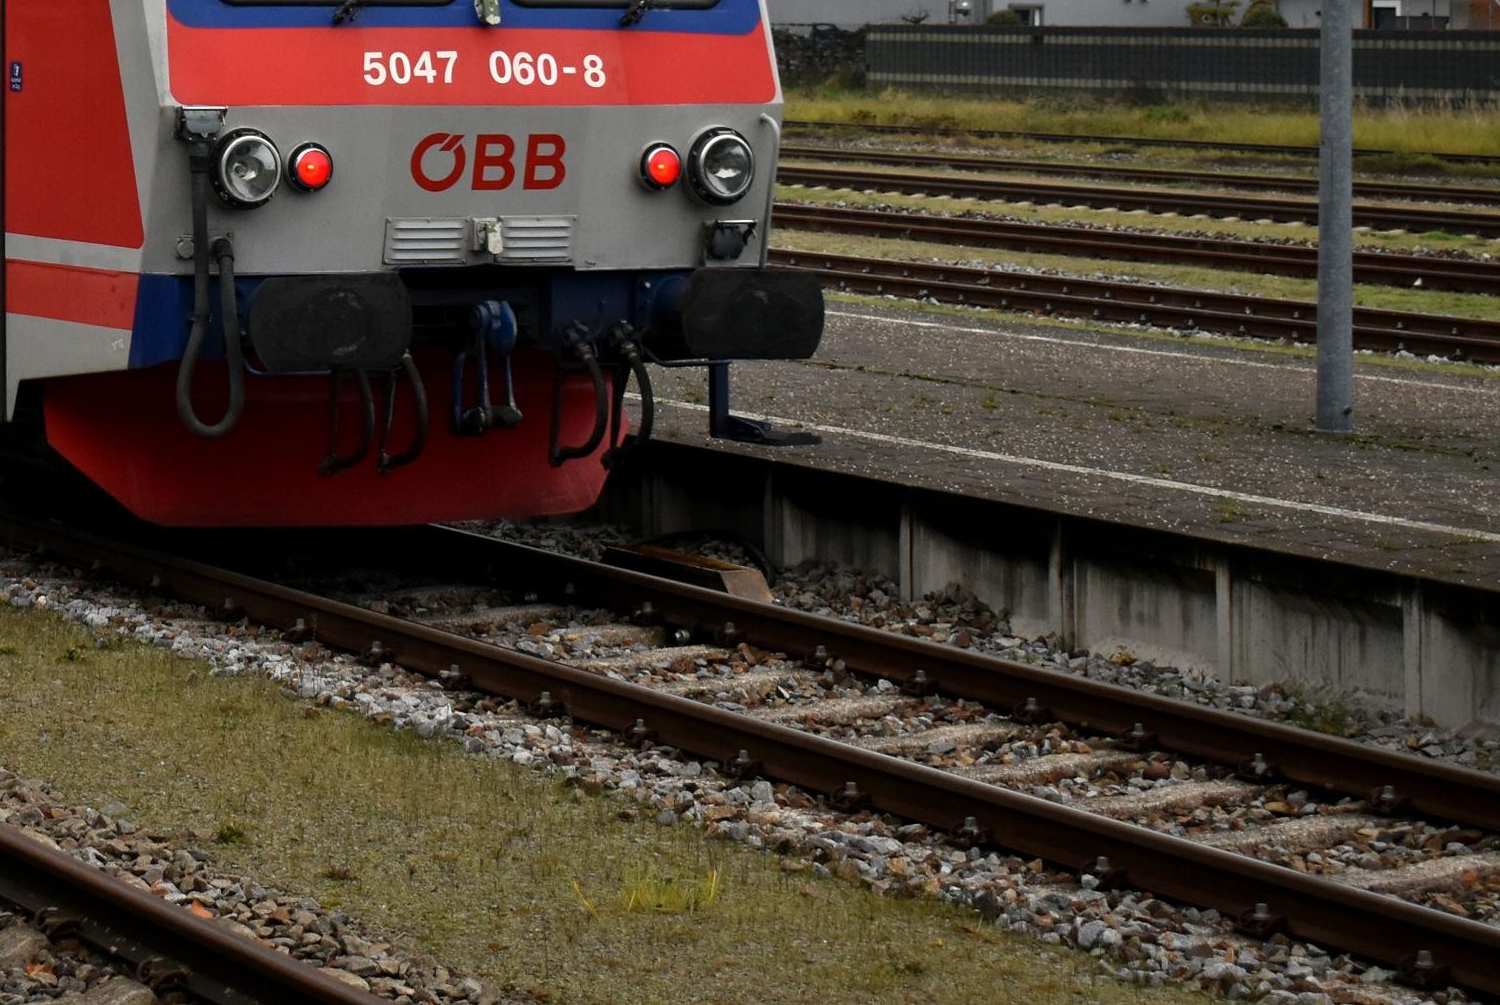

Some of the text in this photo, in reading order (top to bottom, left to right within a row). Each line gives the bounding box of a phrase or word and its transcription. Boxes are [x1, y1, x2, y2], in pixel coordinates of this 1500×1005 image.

[363, 51, 606, 87] 5047 060-8
[410, 132, 566, 193] ÖBB
